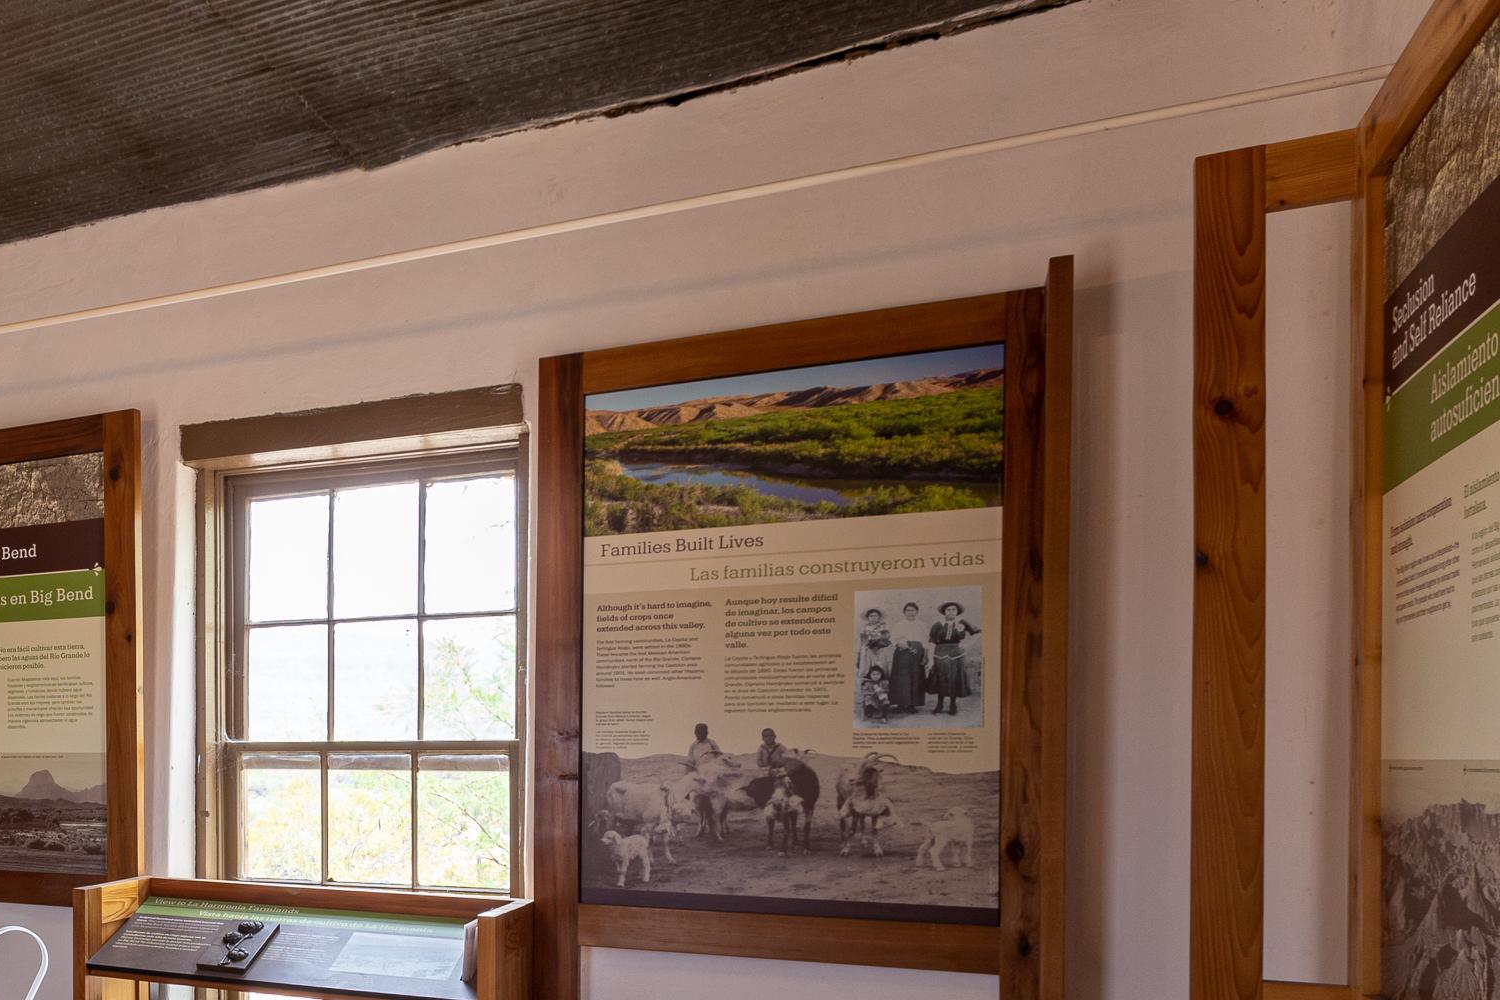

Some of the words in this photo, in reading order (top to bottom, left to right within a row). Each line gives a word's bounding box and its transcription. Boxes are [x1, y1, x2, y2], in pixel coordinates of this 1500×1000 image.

[1392, 273, 1435, 334] Seclusion
[1392, 330, 1409, 370] and
[1408, 309, 1428, 352] Self
[1428, 272, 1477, 335] Reliance
[1430, 331, 1500, 404] Aislamiento
[1, 543, 36, 561] Bend
[601, 538, 671, 557] Families
[675, 535, 713, 552] Built
[718, 532, 763, 549] Lives
[690, 565, 718, 582] Las
[723, 560, 794, 580] familias
[798, 553, 925, 577] construyeron
[929, 550, 985, 569] vidas
[9, 594, 26, 605] en
[30, 588, 52, 607] Big
[56, 585, 93, 602] Bend
[596, 601, 632, 614] Although
[633, 600, 645, 610] it's
[646, 599, 665, 610] hard
[596, 613, 618, 623] fields
[619, 612, 627, 622] of
[629, 614, 651, 623] crops
[596, 622, 633, 633] extended
[635, 623, 661, 631] across
[662, 620, 677, 630] this
[678, 619, 705, 632] valley.
